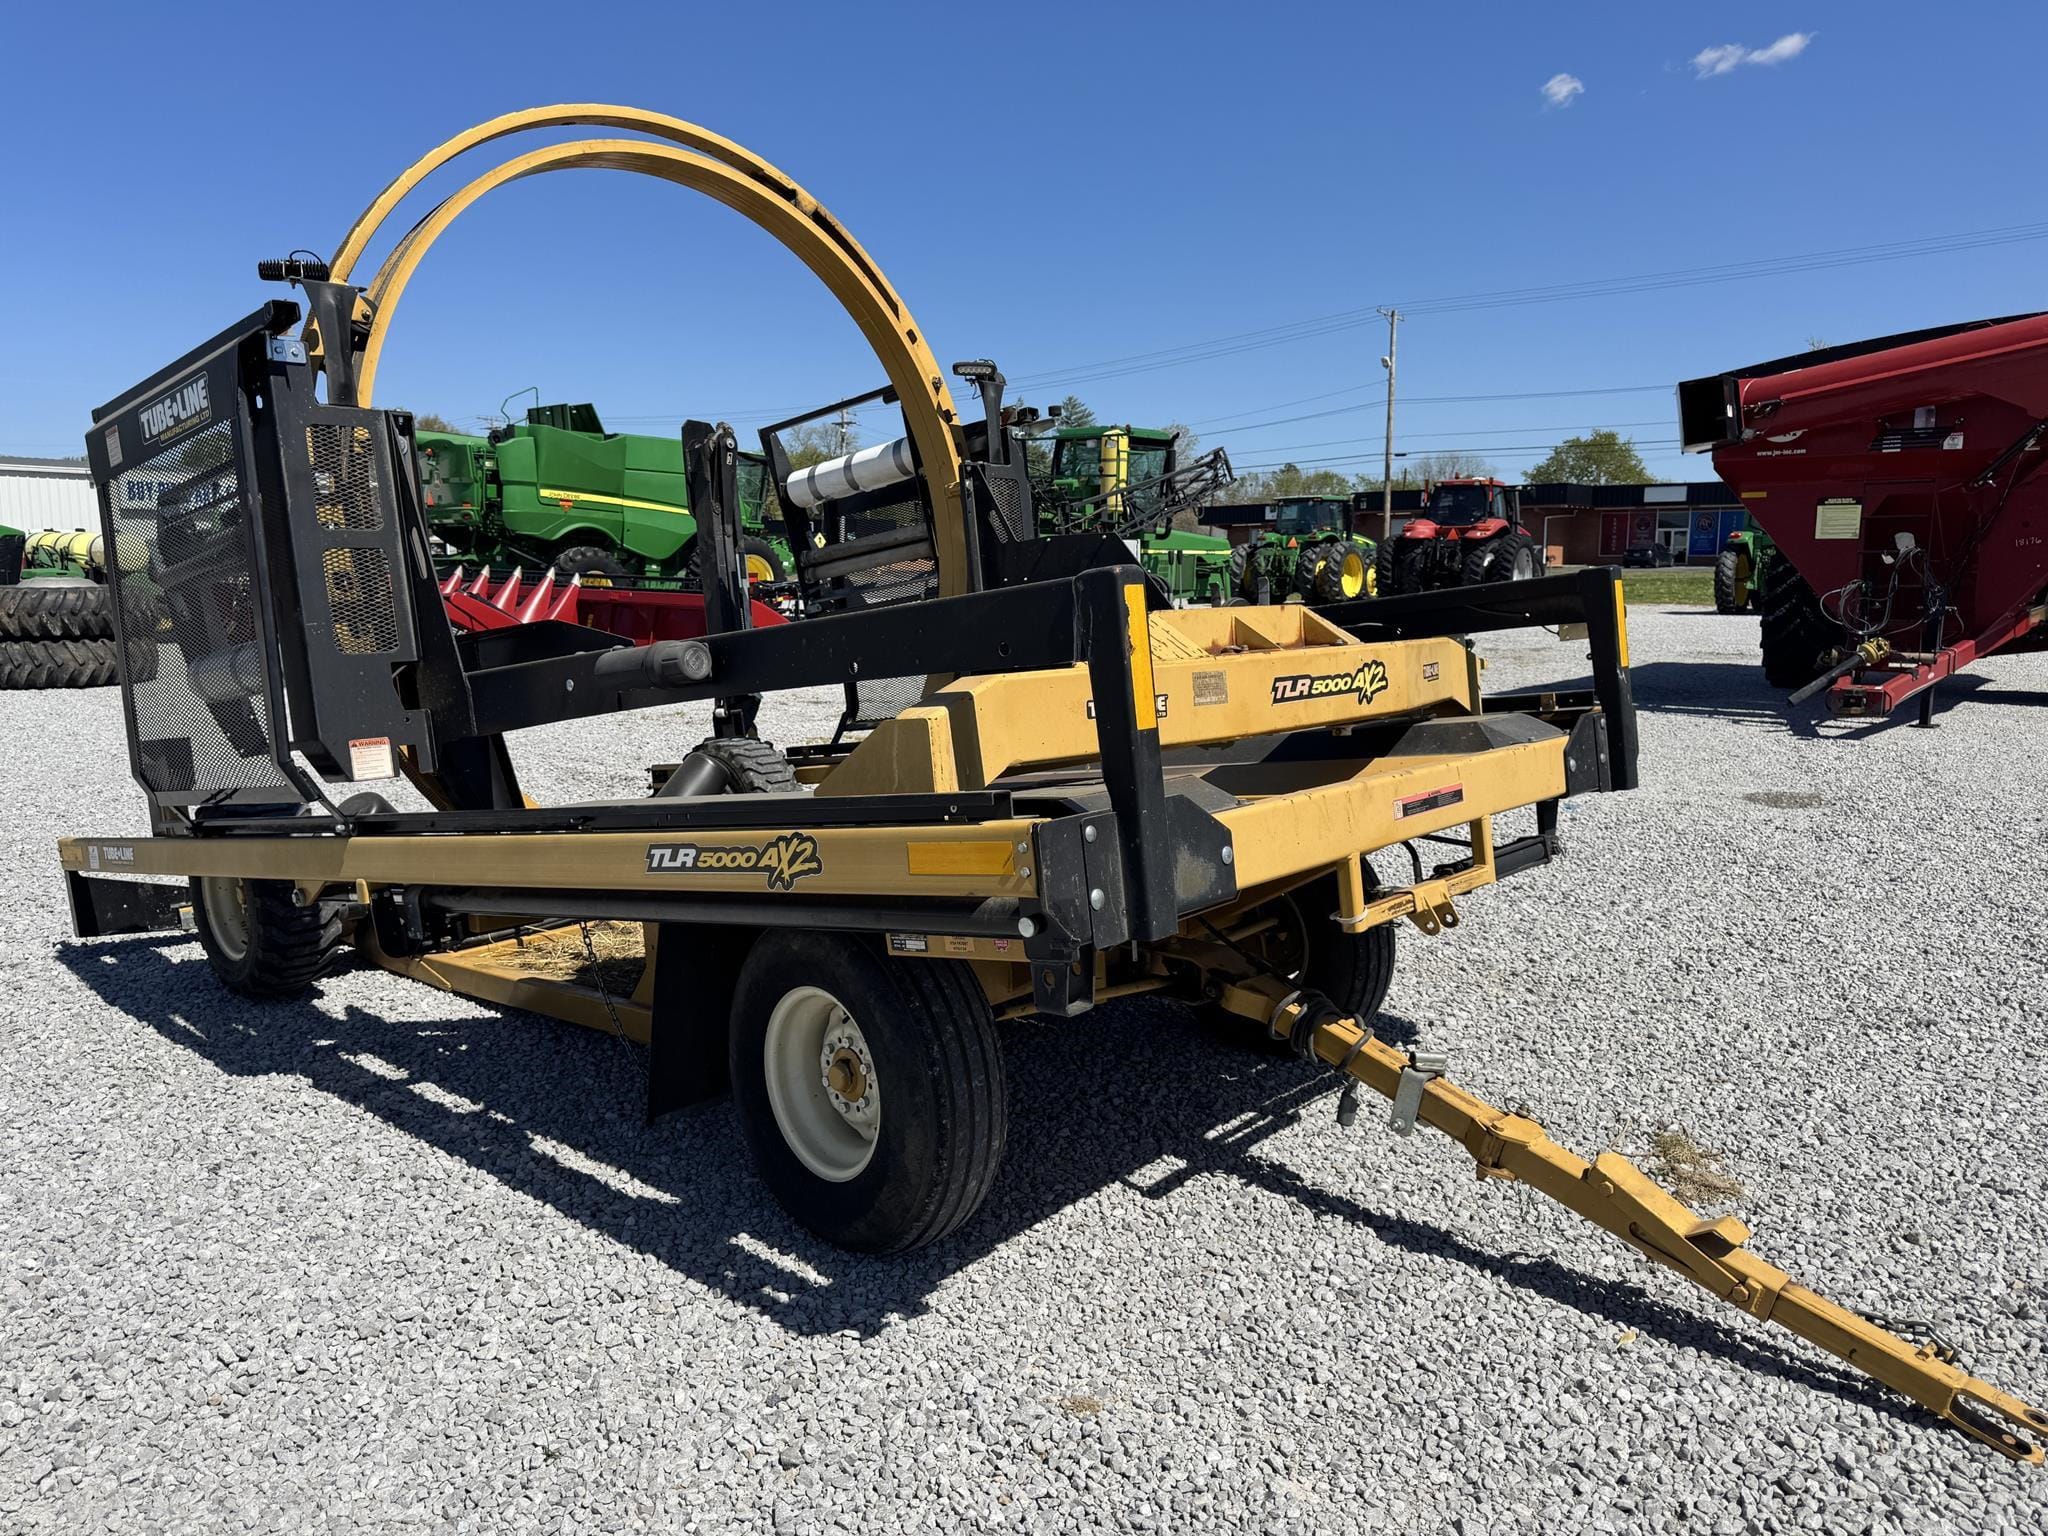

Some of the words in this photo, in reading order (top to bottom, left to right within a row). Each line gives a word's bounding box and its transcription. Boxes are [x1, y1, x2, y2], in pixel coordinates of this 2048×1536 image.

[1275, 678, 1311, 699] TLR
[1311, 677, 1351, 695] 5000
[1352, 663, 1388, 700] AX2
[358, 739, 387, 747] WARNING
[650, 848, 697, 868] TLR
[697, 851, 757, 868] 5000
[757, 837, 818, 887] AX2
